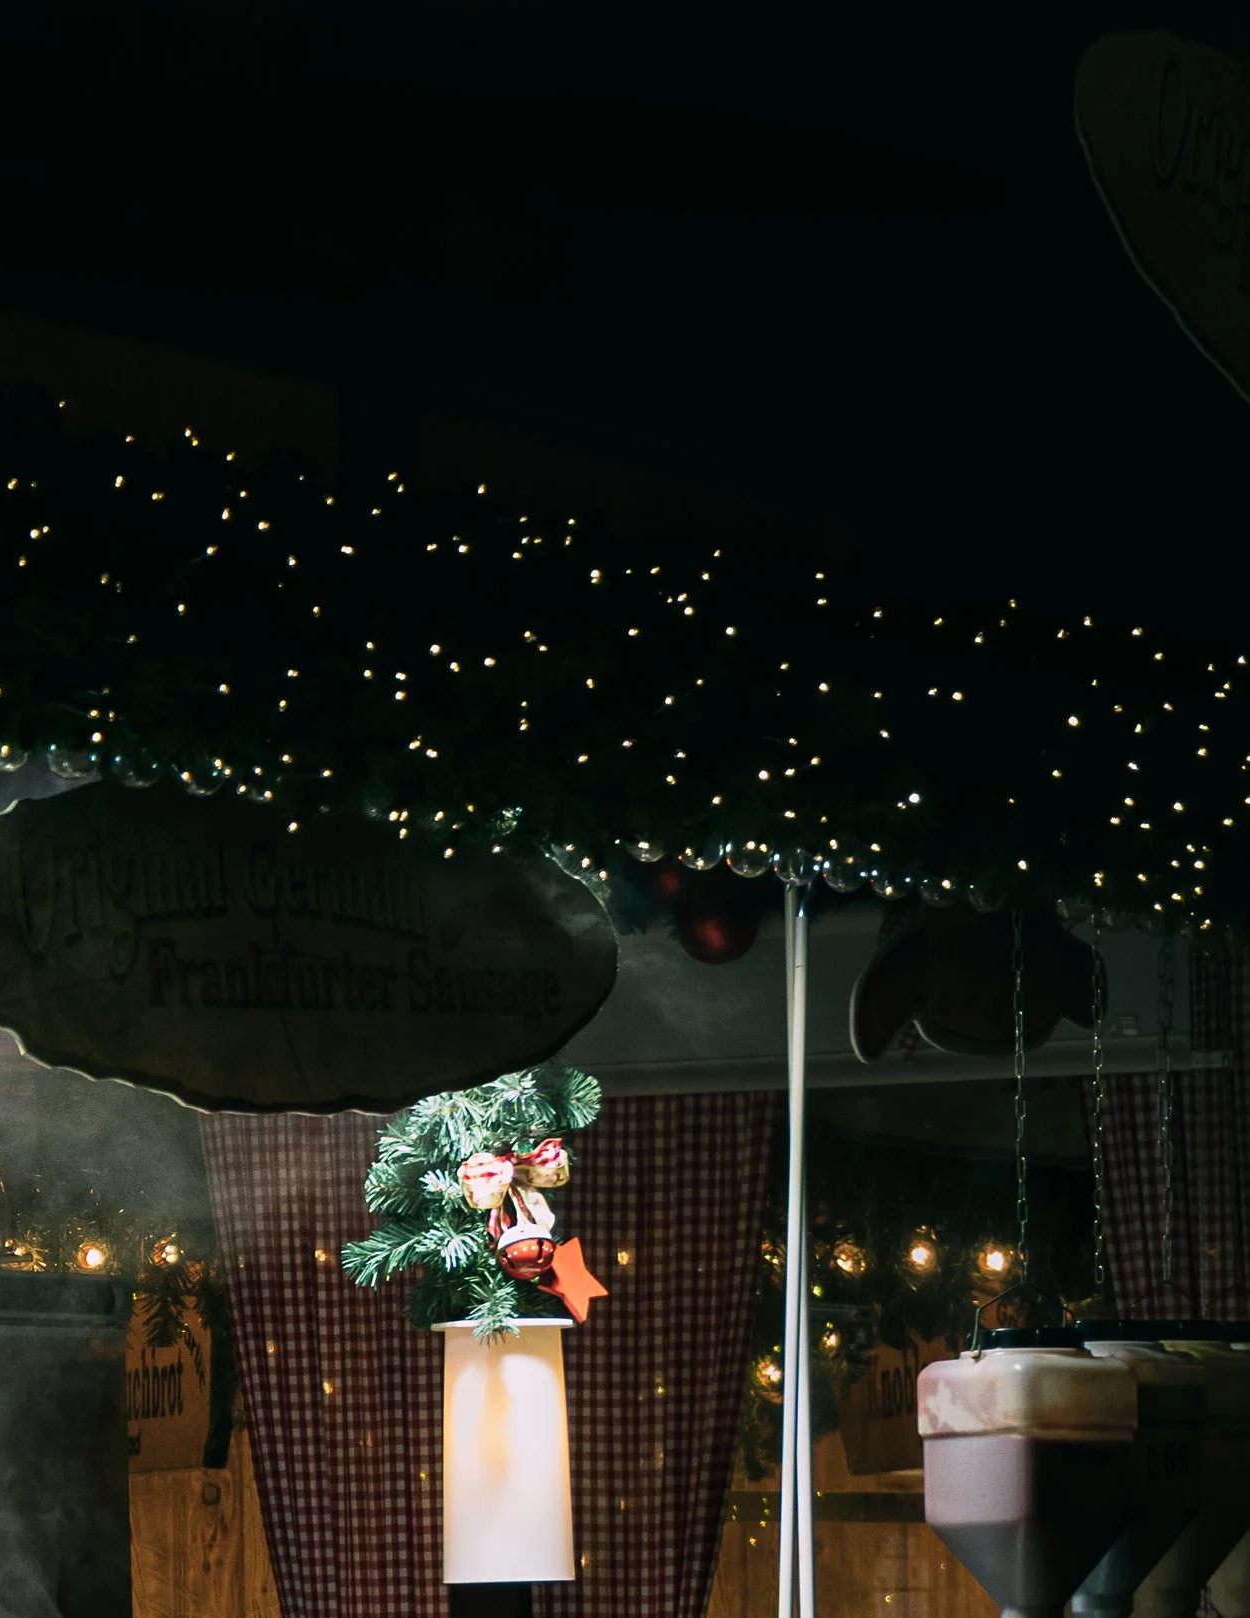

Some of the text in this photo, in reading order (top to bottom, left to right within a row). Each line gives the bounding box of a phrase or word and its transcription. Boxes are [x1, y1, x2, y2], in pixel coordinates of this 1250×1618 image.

[9, 831, 428, 982] Original German
[145, 936, 562, 1034] Frankfurter Sausage
